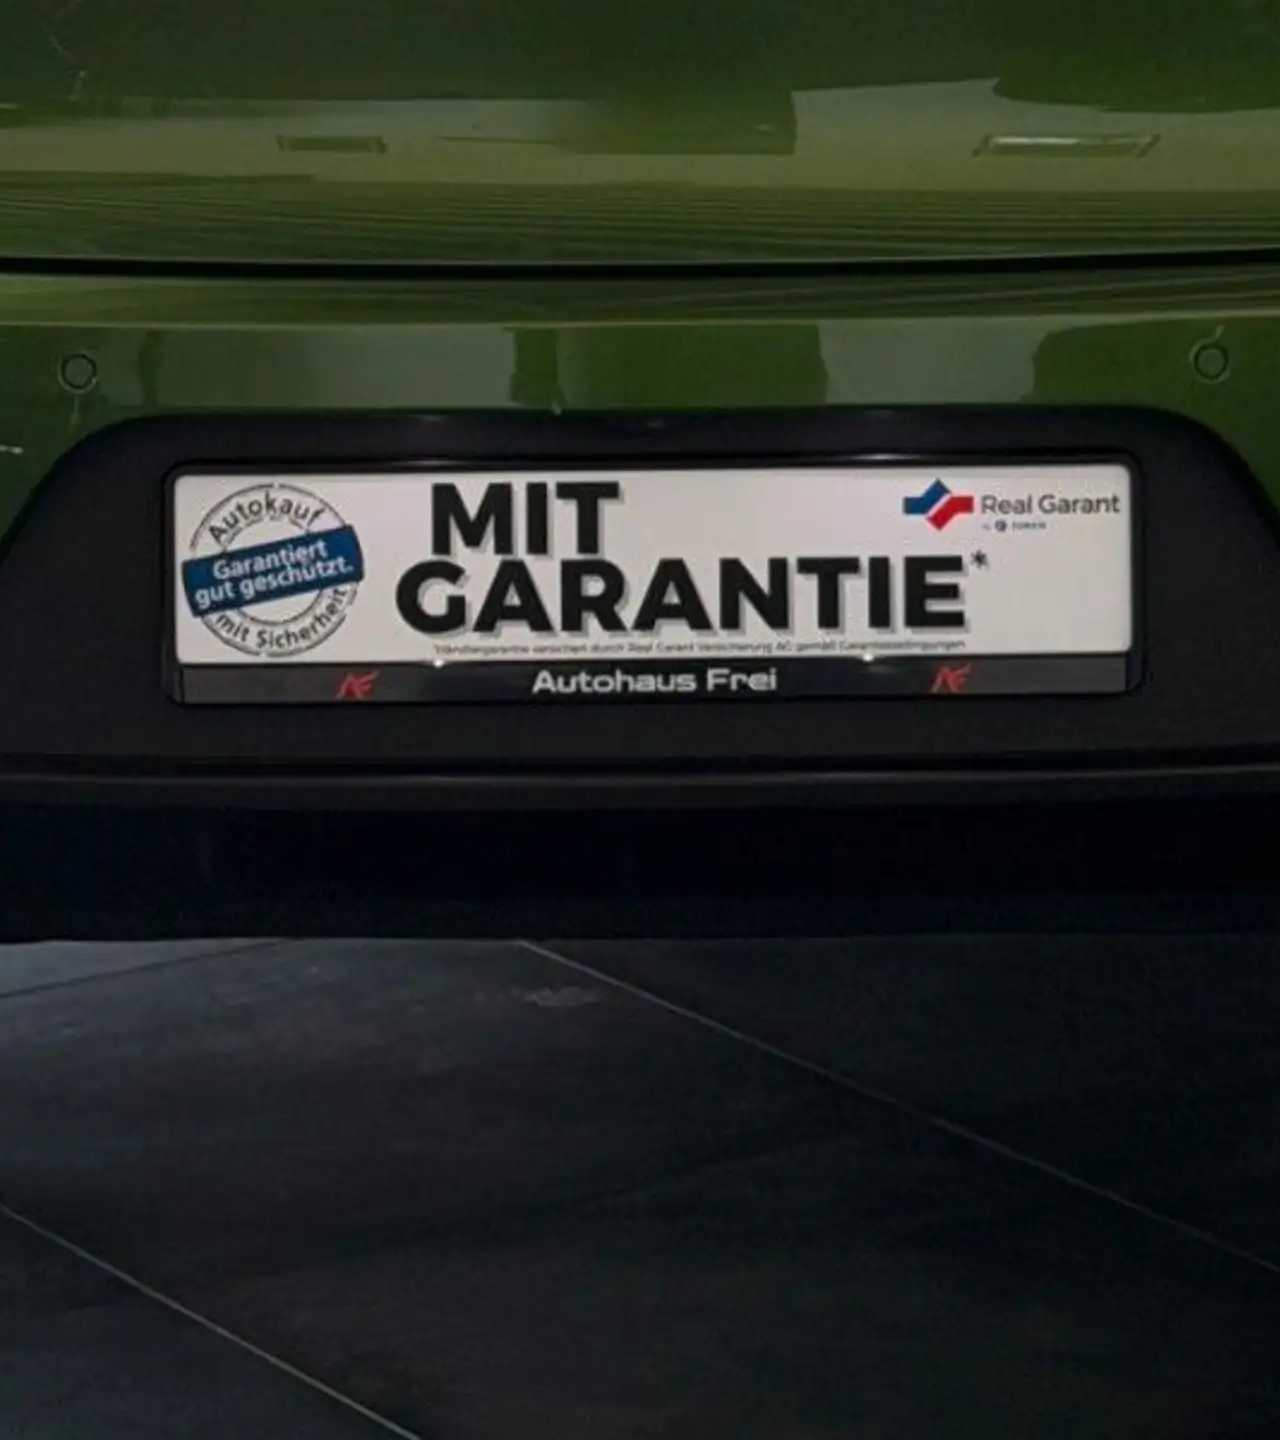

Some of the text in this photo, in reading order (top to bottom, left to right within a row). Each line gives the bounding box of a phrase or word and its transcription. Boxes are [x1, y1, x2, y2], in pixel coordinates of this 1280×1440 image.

[208, 491, 327, 544] Autokauf
[431, 481, 621, 556] MIT
[980, 493, 1121, 515] Real Garant
[212, 537, 329, 581] Garantiert
[194, 582, 237, 610] gut
[215, 586, 349, 650] mit Sicherheit
[531, 666, 778, 695] Autohaus Frei
